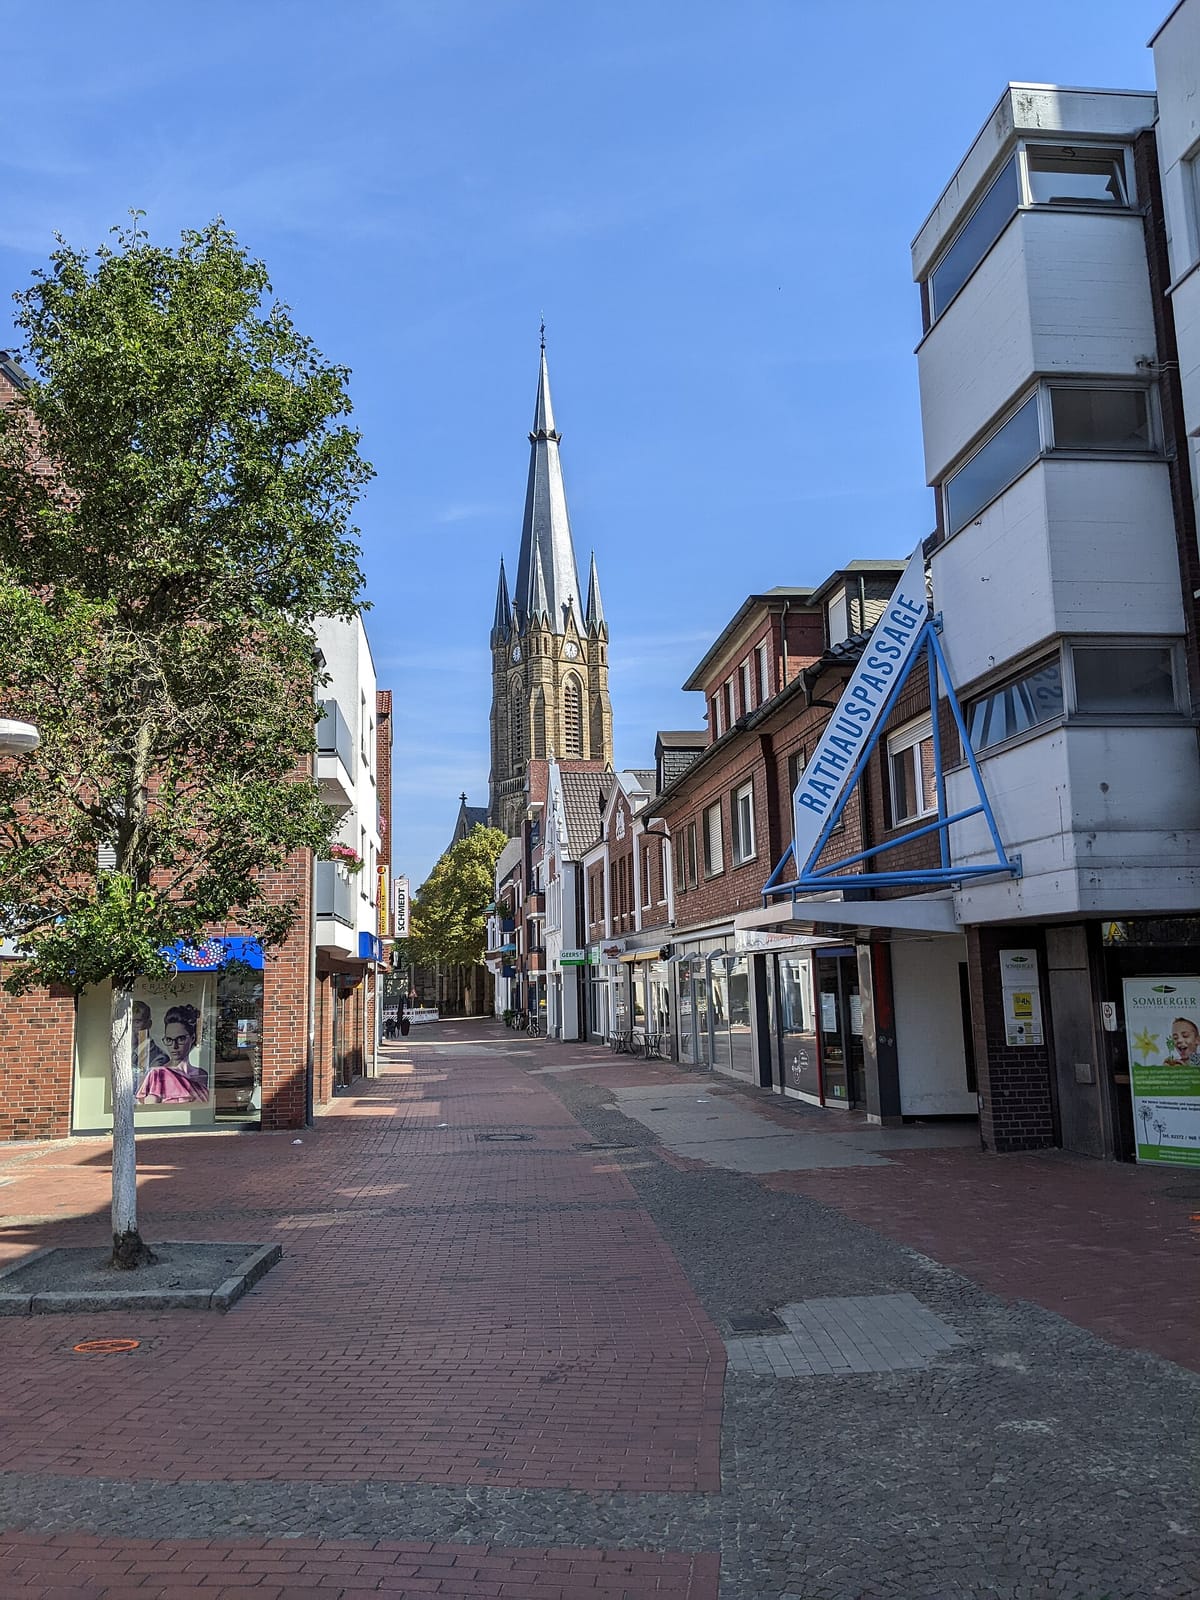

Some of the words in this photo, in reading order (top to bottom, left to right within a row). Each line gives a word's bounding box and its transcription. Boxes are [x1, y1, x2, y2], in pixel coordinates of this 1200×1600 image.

[797, 593, 925, 816] RATHAUSPASSAGE
[398, 887, 406, 932] SCHMEDT
[1132, 996, 1197, 1006] SOMBERGER
